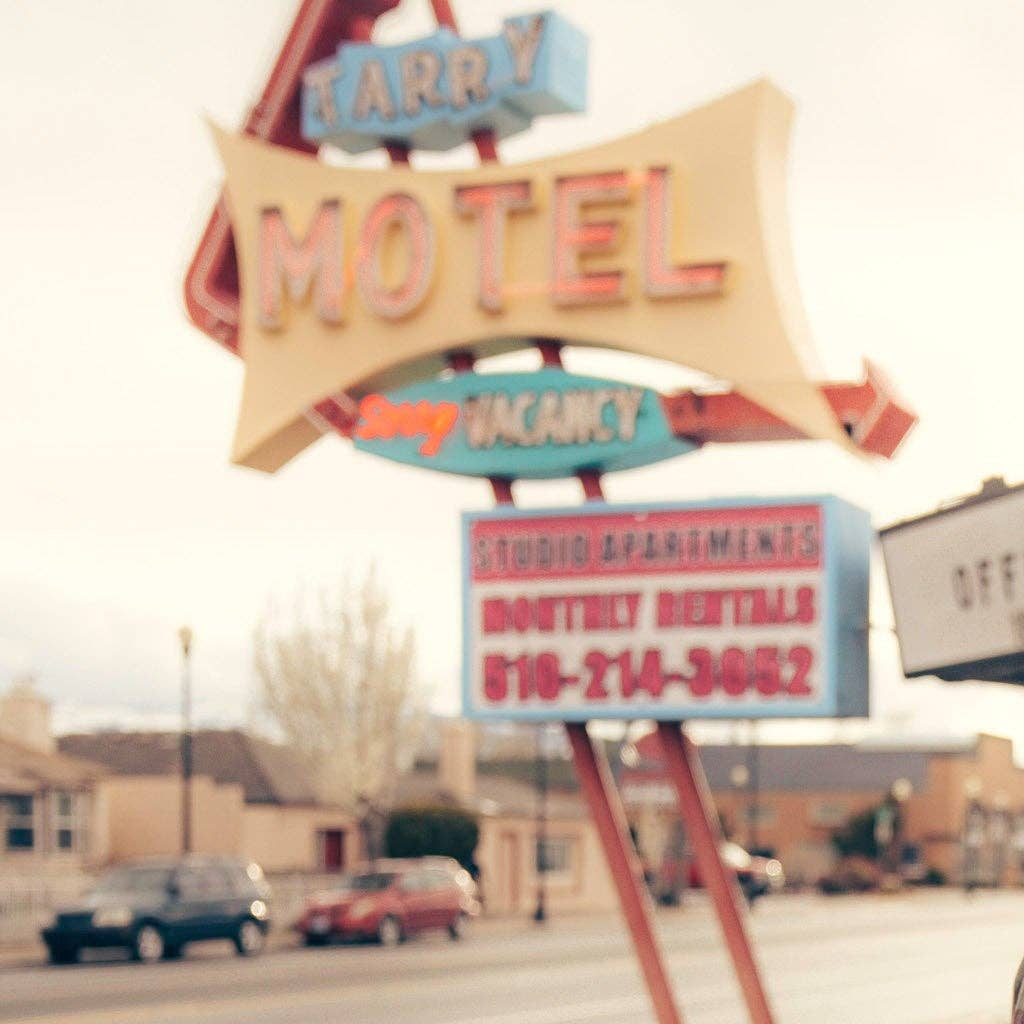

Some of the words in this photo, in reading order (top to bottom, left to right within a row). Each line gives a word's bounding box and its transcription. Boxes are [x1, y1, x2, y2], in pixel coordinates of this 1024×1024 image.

[304, 18, 544, 125] TARRY
[259, 166, 727, 331] MOTEL
[464, 386, 644, 449] VACANCY
[474, 531, 589, 571] STUDIO
[601, 520, 818, 563] APARTMENTS
[483, 593, 641, 634] MONTHLY
[657, 585, 815, 627] RENTALS
